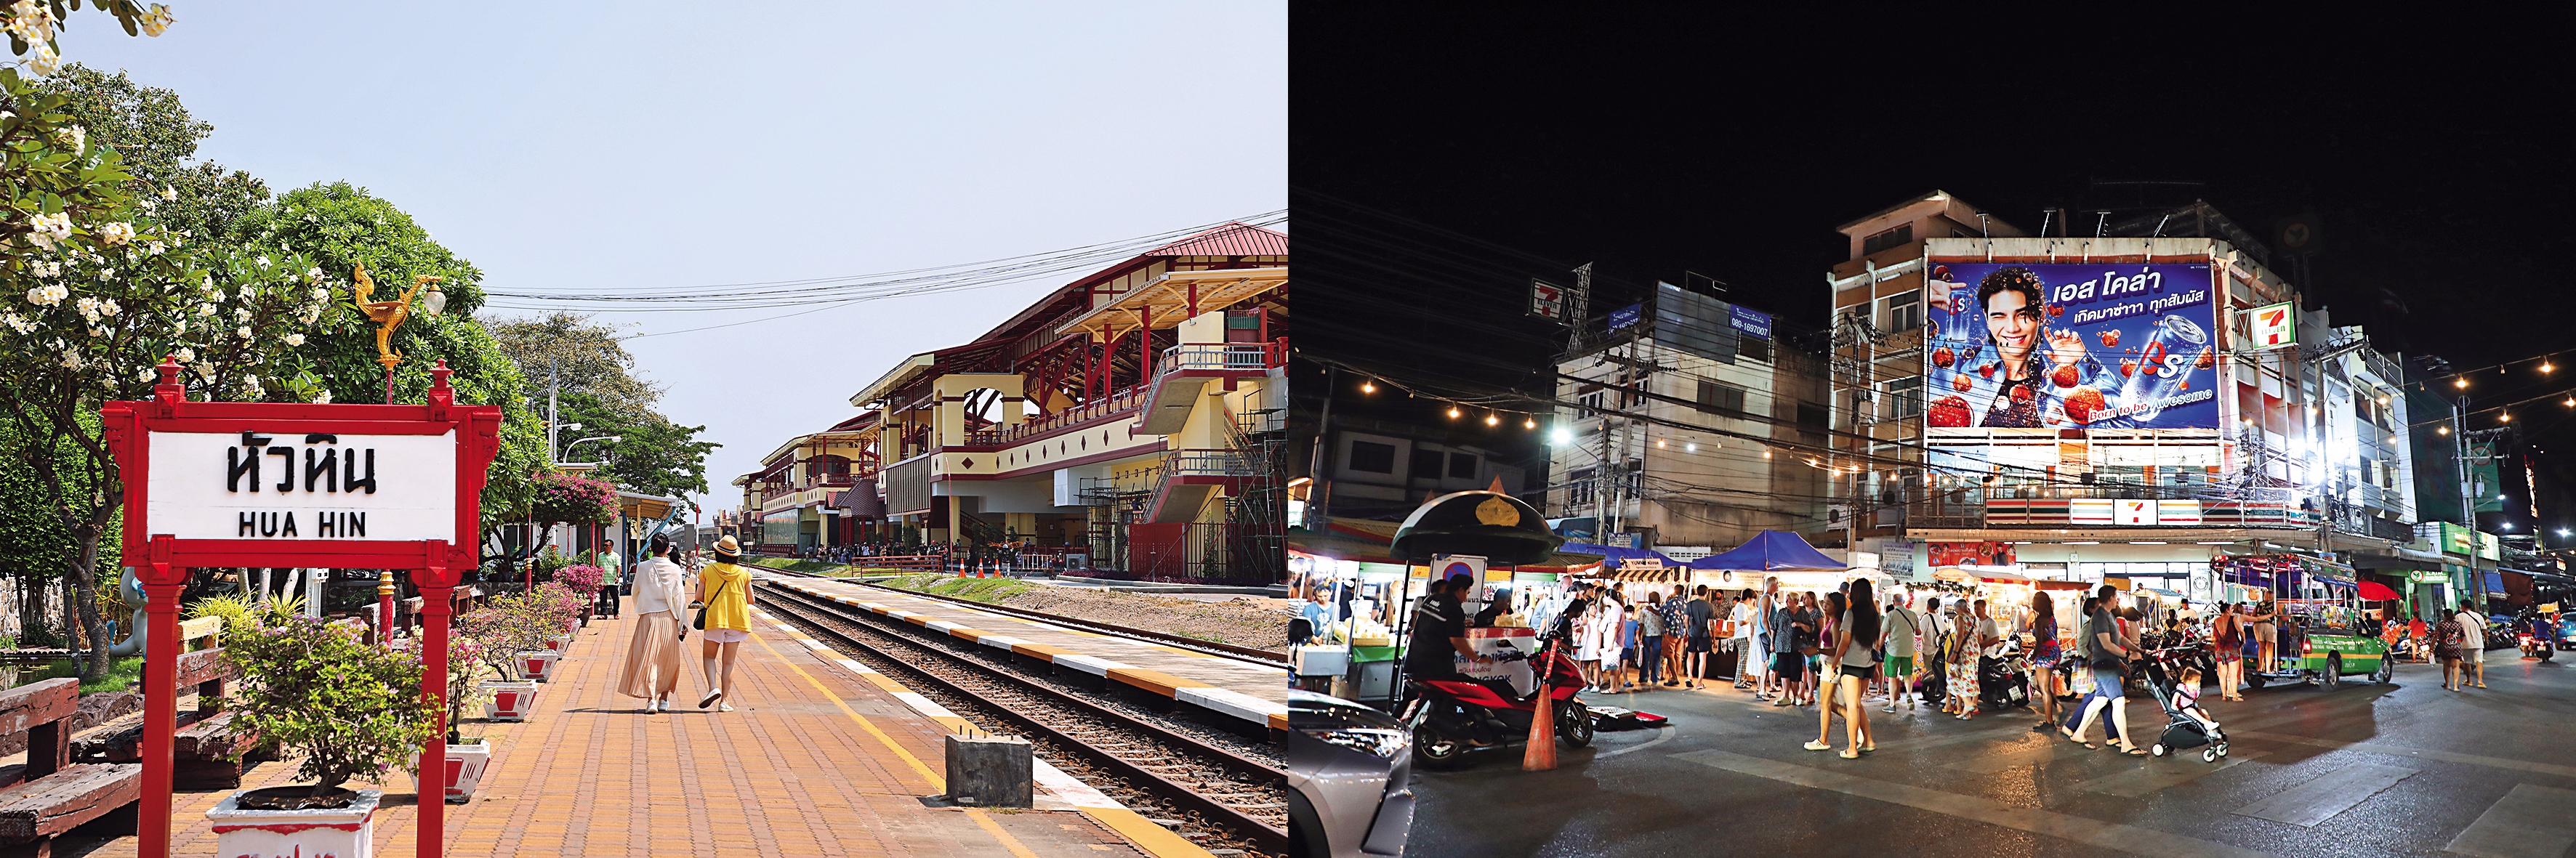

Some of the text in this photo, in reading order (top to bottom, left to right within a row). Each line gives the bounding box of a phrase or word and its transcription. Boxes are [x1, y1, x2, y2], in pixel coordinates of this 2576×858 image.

[2052, 267, 2161, 303] เอส โคล่า
[1539, 286, 1558, 317] 7
[2149, 290, 2205, 313] ทุกสัมผัส
[1731, 317, 1768, 336] 089-1697007
[2260, 309, 2284, 344] 7
[2089, 389, 2213, 422] Born to be Awesome
[228, 431, 377, 494] หัวหิน
[239, 511, 366, 538] HUA HIN
[2128, 502, 2144, 522] 7
